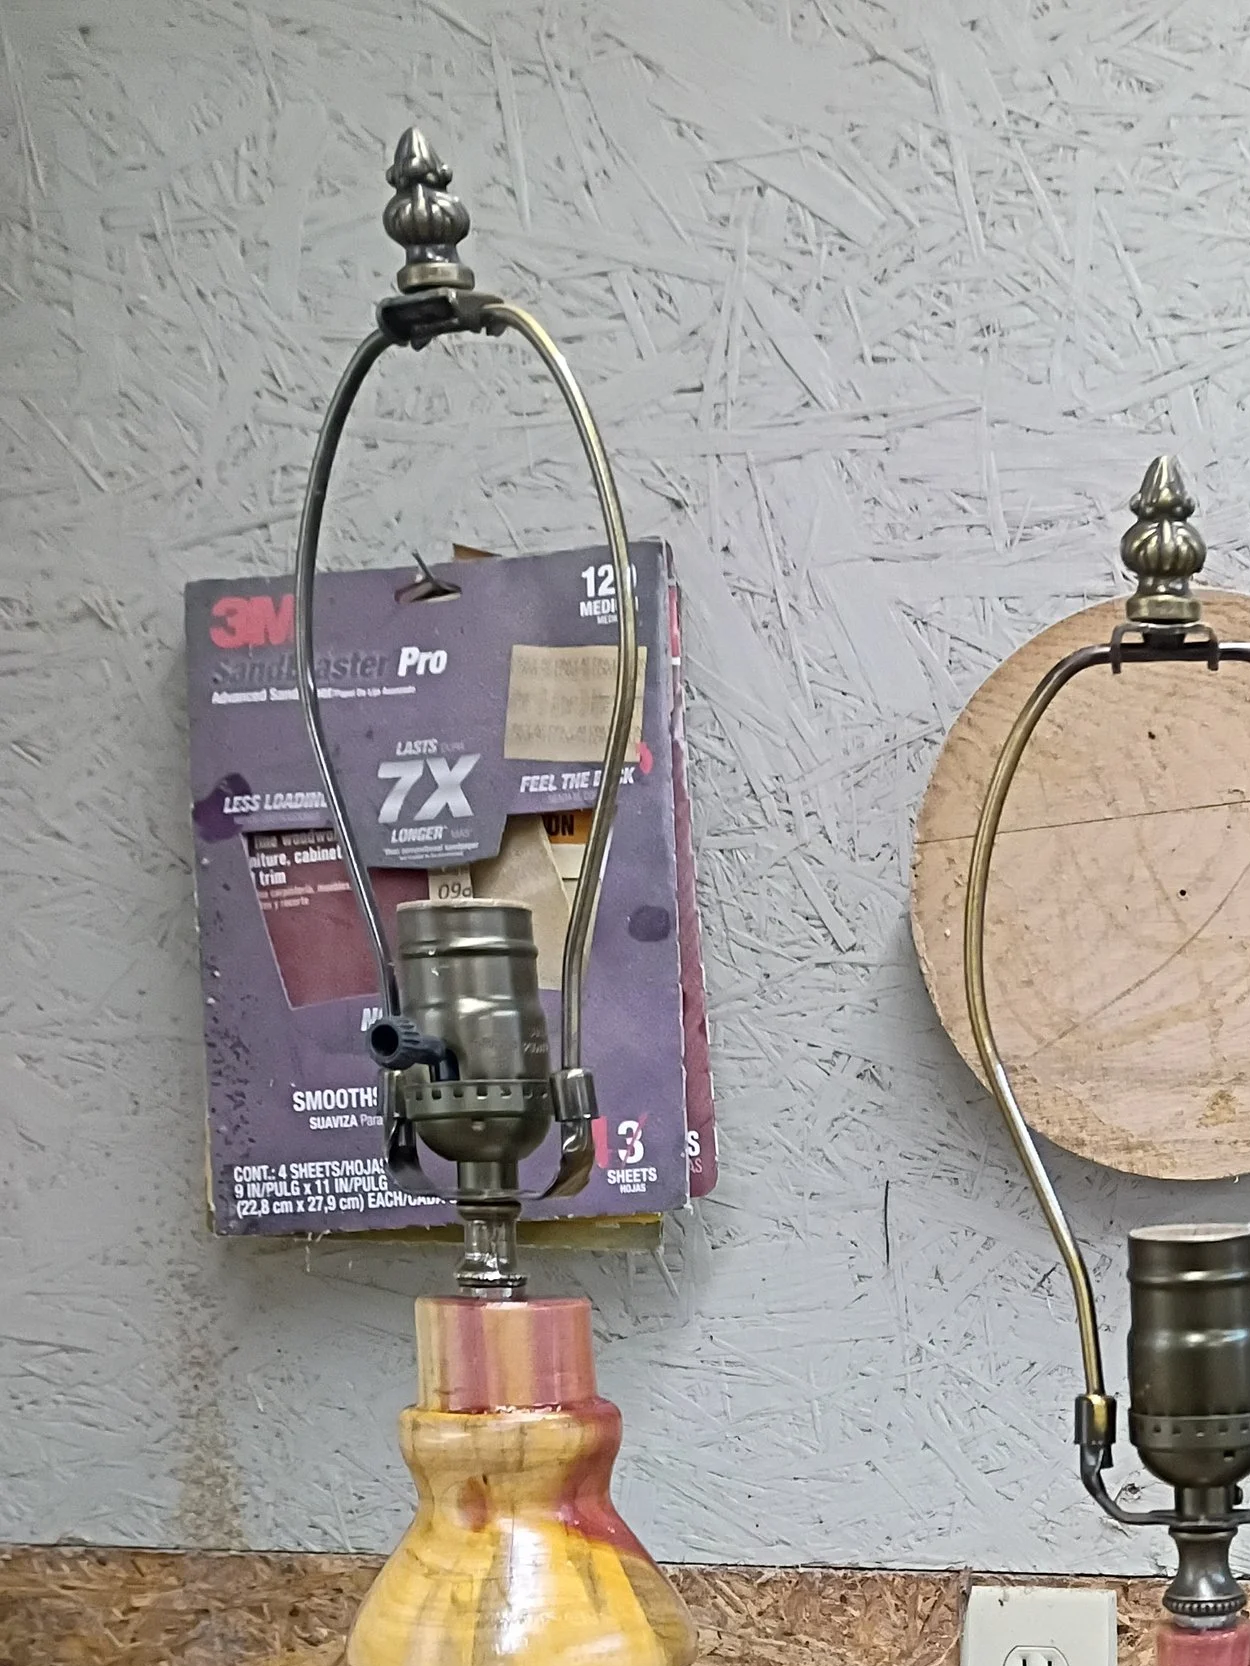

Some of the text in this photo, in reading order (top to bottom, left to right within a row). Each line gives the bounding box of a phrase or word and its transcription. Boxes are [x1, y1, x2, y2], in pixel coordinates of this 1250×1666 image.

[580, 596, 639, 617] MEDI
[209, 593, 296, 648] 3M
[397, 646, 447, 677] Pro
[396, 738, 438, 756] LASTS
[377, 753, 481, 824] 7X
[520, 774, 557, 792] FEEL
[561, 771, 591, 790] THE
[223, 794, 261, 814] LESS
[294, 844, 343, 864] cabinet
[259, 870, 287, 886] trim
[309, 1113, 383, 1130] SUAVIZA Para
[617, 1120, 645, 1164] 3
[233, 1164, 275, 1182] CONT.:
[278, 1163, 287, 1180] 4
[607, 1167, 658, 1185] SHEETS
[234, 1175, 388, 1199] 9 IN/PULG x 11 IN/PULG
[619, 1183, 646, 1194] HOJAS
[236, 1199, 270, 1219] (22,8
[272, 1202, 294, 1214] cm
[296, 1201, 305, 1213] x
[307, 1196, 337, 1215] 27,9
[339, 1194, 364, 1212] cm)
